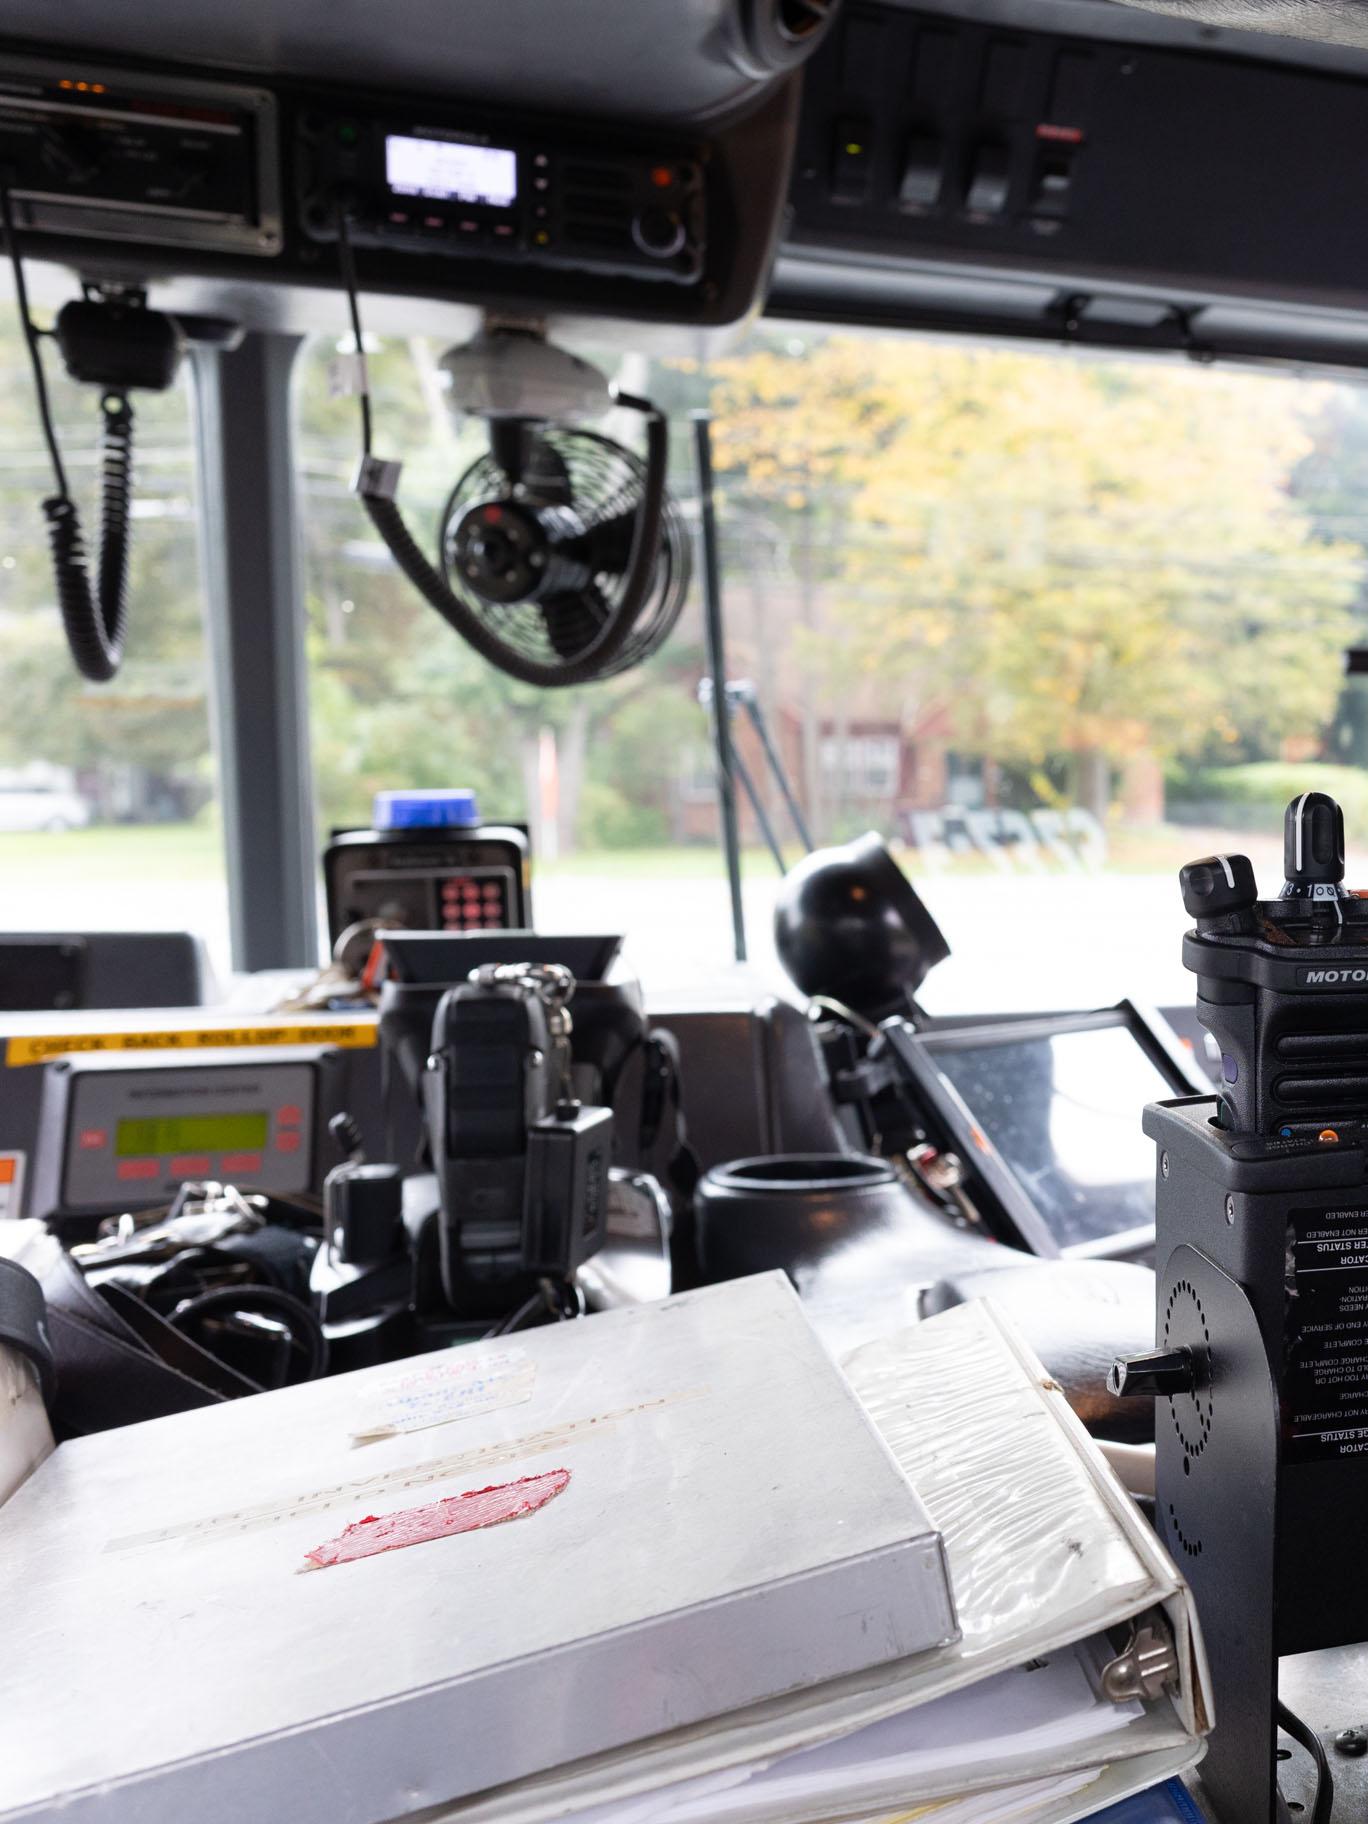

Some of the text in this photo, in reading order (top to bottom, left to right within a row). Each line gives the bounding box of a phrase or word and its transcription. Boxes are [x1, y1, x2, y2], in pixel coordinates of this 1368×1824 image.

[29, 1037, 105, 1057] CHECK
[1325, 1210, 1358, 1220] ENABLED
[1306, 1230, 1340, 1238] ENABLED
[1316, 1242, 1352, 1252] STATUS
[1339, 1303, 1363, 1312] NEEDS
[1301, 1323, 1333, 1333] SERVICE
[1334, 1322, 1345, 1330] OF
[1346, 1321, 1361, 1329] END
[1323, 1338, 1362, 1349] COMPLETE
[1300, 1358, 1338, 1368] COMPLETE
[1314, 1367, 1344, 1376] CHARGE
[1344, 1374, 1359, 1382] TOO
[1340, 1391, 1368, 1400] CHARGE
[1293, 1411, 1342, 1422] CHARGEABLE
[1344, 1408, 1359, 1417] NOT
[1320, 1431, 1355, 1442] STATUS
